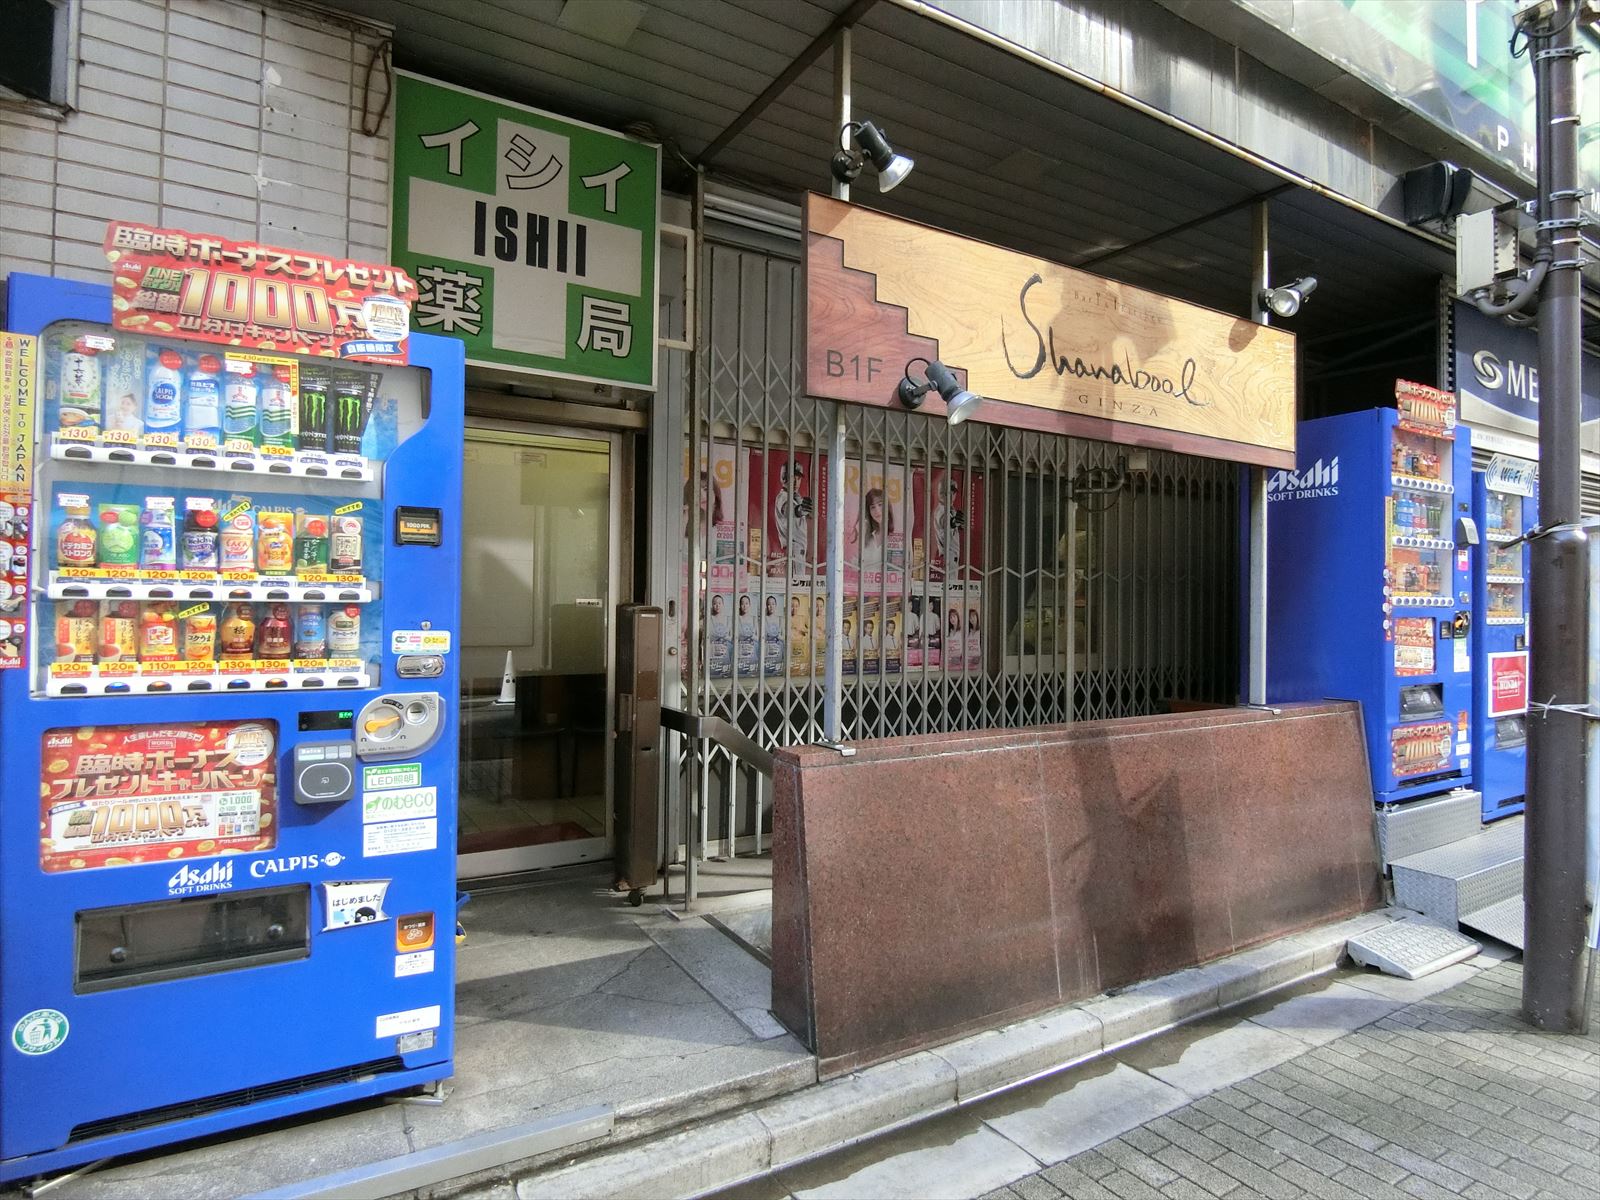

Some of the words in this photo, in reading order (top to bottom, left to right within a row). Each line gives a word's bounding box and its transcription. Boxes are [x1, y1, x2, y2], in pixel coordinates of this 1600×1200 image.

[474, 200, 587, 278] ISHII
[112, 226, 414, 293] 臨時ボーナスプレゼント
[147, 267, 181, 281] LINE
[178, 316, 335, 347] 山分けキャンペーン
[18, 338, 31, 407] WELCOME
[826, 349, 883, 383] B1F
[1078, 394, 1158, 417] GINZA
[17, 413, 26, 428] TO
[15, 434, 27, 482] JAPAN
[1268, 456, 1339, 492] Asahi
[1267, 491, 1293, 502] SOFT
[1296, 486, 1338, 499] DRINKS
[47, 736, 73, 746] Asahi
[76, 749, 238, 776] 臨時ボーナス
[51, 769, 262, 800] プレゼントキャンペーン
[371, 774, 414, 786] LED照明
[168, 860, 233, 888] Asahi
[250, 854, 319, 878] CALPIS
[168, 885, 194, 896] SOFT
[196, 881, 233, 892] DRINKS
[332, 893, 381, 907] はじめました
